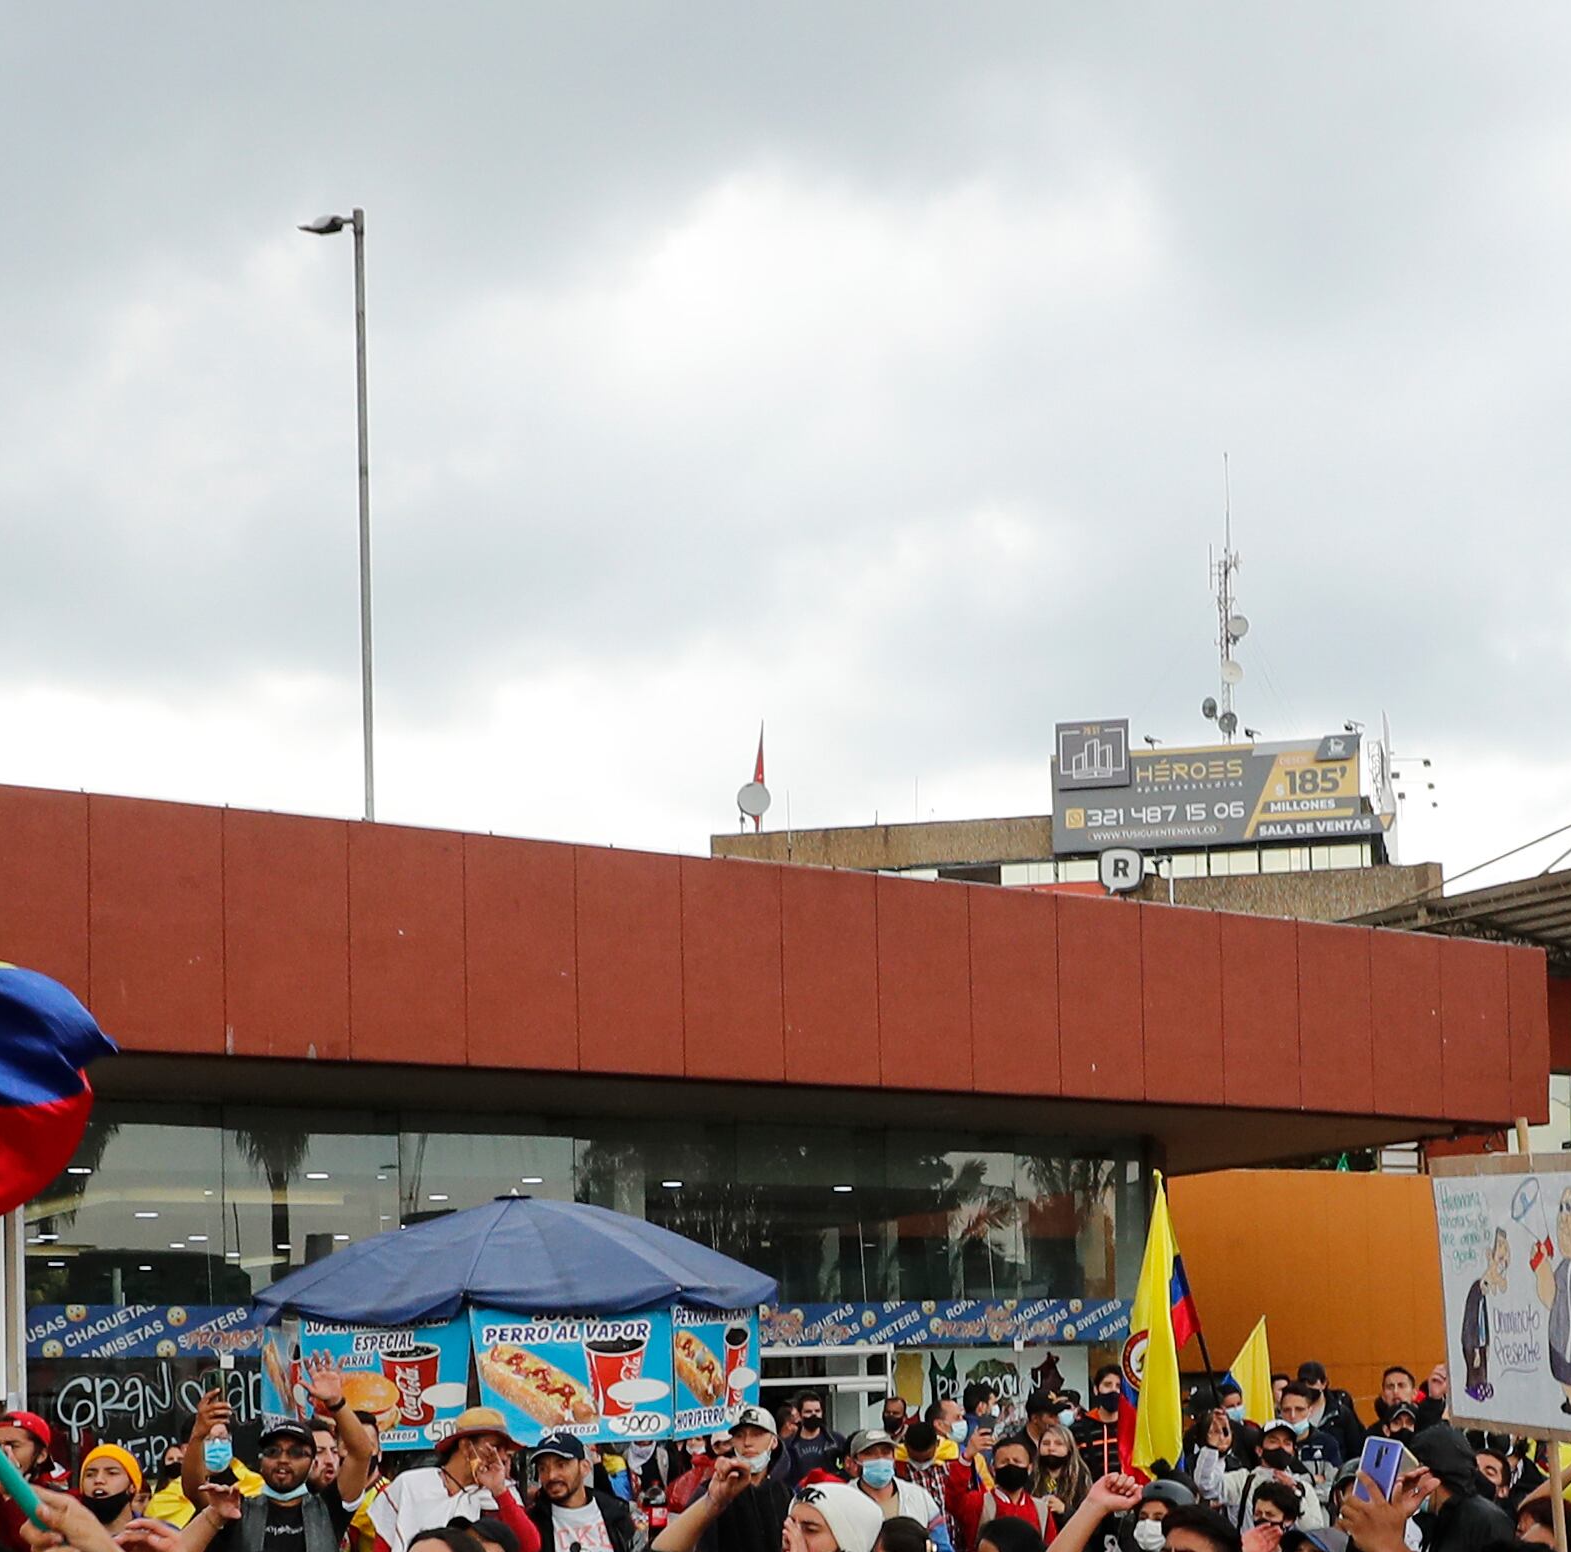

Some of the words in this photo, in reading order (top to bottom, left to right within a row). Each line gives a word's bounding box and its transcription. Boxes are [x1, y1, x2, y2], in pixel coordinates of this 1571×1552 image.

[1137, 758, 1242, 783] HÉROES
[1087, 809, 1124, 827] 321
[1131, 805, 1176, 824] 487
[1185, 804, 1206, 821] 15
[1214, 801, 1245, 819] 06
[1271, 799, 1335, 812] MILLONES
[1259, 825, 1293, 836] SALA
[1296, 822, 1314, 833] DE
[1316, 819, 1371, 832] VENTAS
[1113, 857, 1129, 878] R
[1076, 1298, 1123, 1332] SWETERS
[26, 1315, 68, 1344] USAS
[81, 1319, 165, 1358] AMISETAS
[177, 1307, 248, 1348] SETERS
[484, 1326, 554, 1344] PERRO
[556, 1325, 578, 1339] AL
[584, 1322, 649, 1340] VAPOR
[869, 1309, 921, 1345] SWETERS
[1097, 1315, 1129, 1341] JEANS
[354, 1332, 414, 1352] ESPECIAL
[345, 1354, 372, 1367] ARNE
[618, 1415, 661, 1434] 3000
[675, 1408, 725, 1430] HORIPERRO
